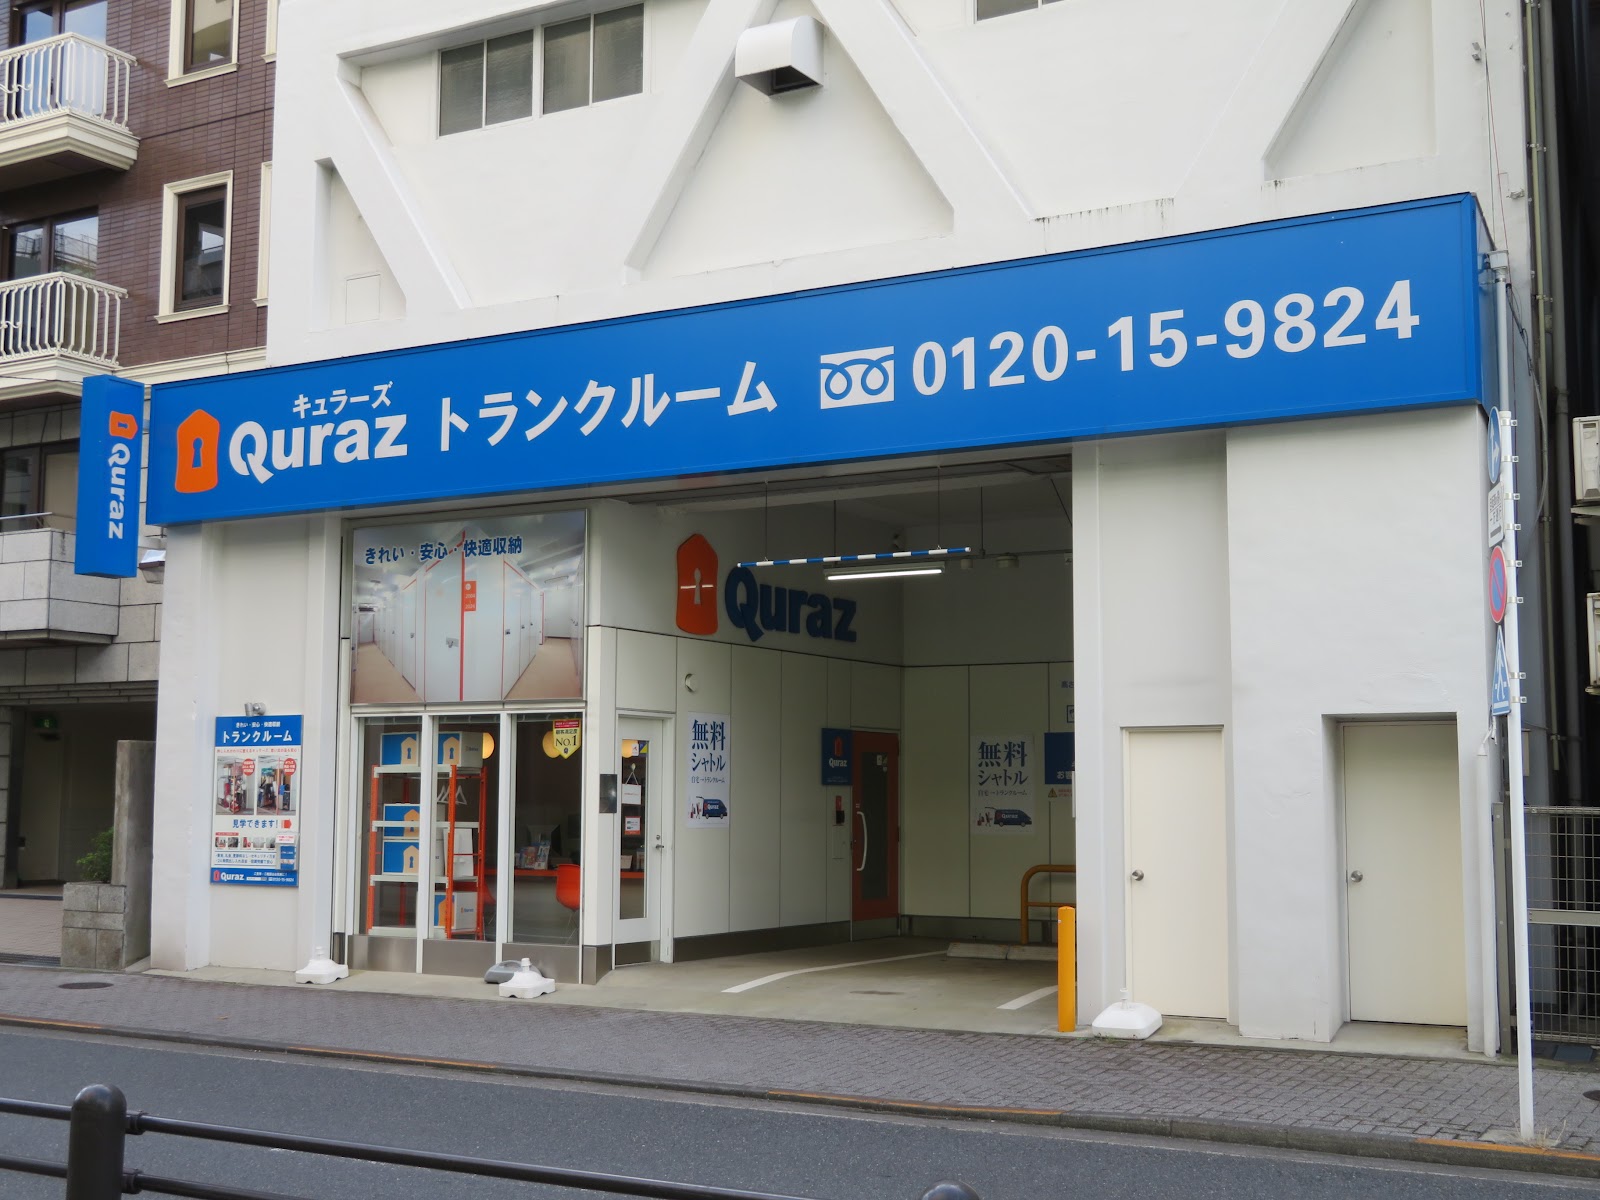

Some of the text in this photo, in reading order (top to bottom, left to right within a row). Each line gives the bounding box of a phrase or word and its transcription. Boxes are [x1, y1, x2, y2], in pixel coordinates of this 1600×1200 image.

[912, 279, 1420, 396] 0120-15-9824
[292, 381, 393, 419] キュラーズ
[440, 361, 778, 452] トランクルーム
[228, 414, 408, 484] Quraz
[108, 442, 131, 540] Quraz
[364, 536, 523, 565] きれい・安心・快適収納
[724, 566, 857, 642] Quraz
[223, 730, 293, 743] トランクルーム
[691, 719, 726, 751] 無料
[691, 752, 727, 773] シャトル
[828, 758, 848, 768] Quraz
[977, 741, 1028, 768] 無料
[977, 769, 1029, 787] シャトル
[220, 872, 245, 882] Quraz
